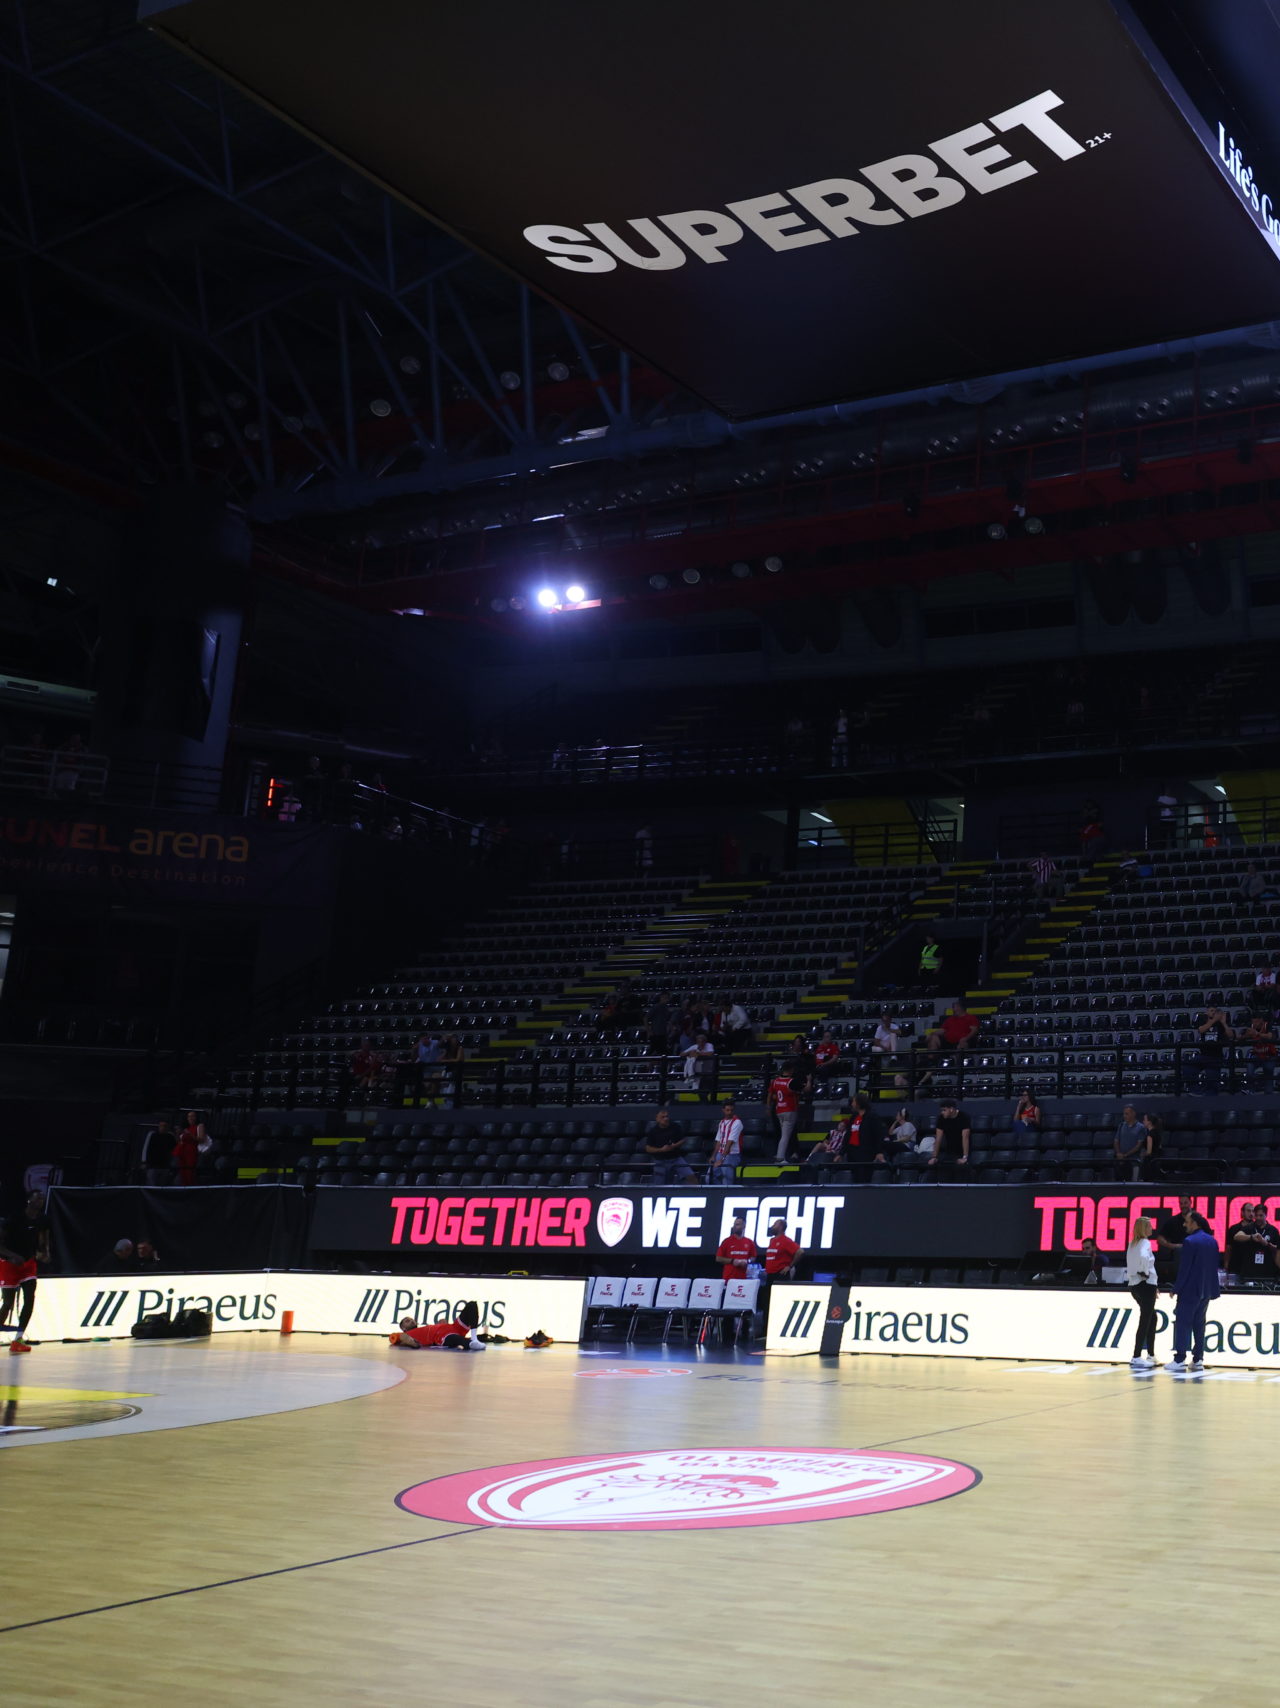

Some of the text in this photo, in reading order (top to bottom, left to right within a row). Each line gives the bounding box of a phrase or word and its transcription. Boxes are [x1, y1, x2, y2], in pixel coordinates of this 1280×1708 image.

[1085, 132, 1112, 148] 21+
[523, 89, 1087, 273] SUPERBET
[1218, 121, 1259, 212] Life's
[128, 827, 250, 864] arena
[390, 1196, 846, 1249] TOGETHER WE FIGHT
[845, 1300, 969, 1344] iraeus
